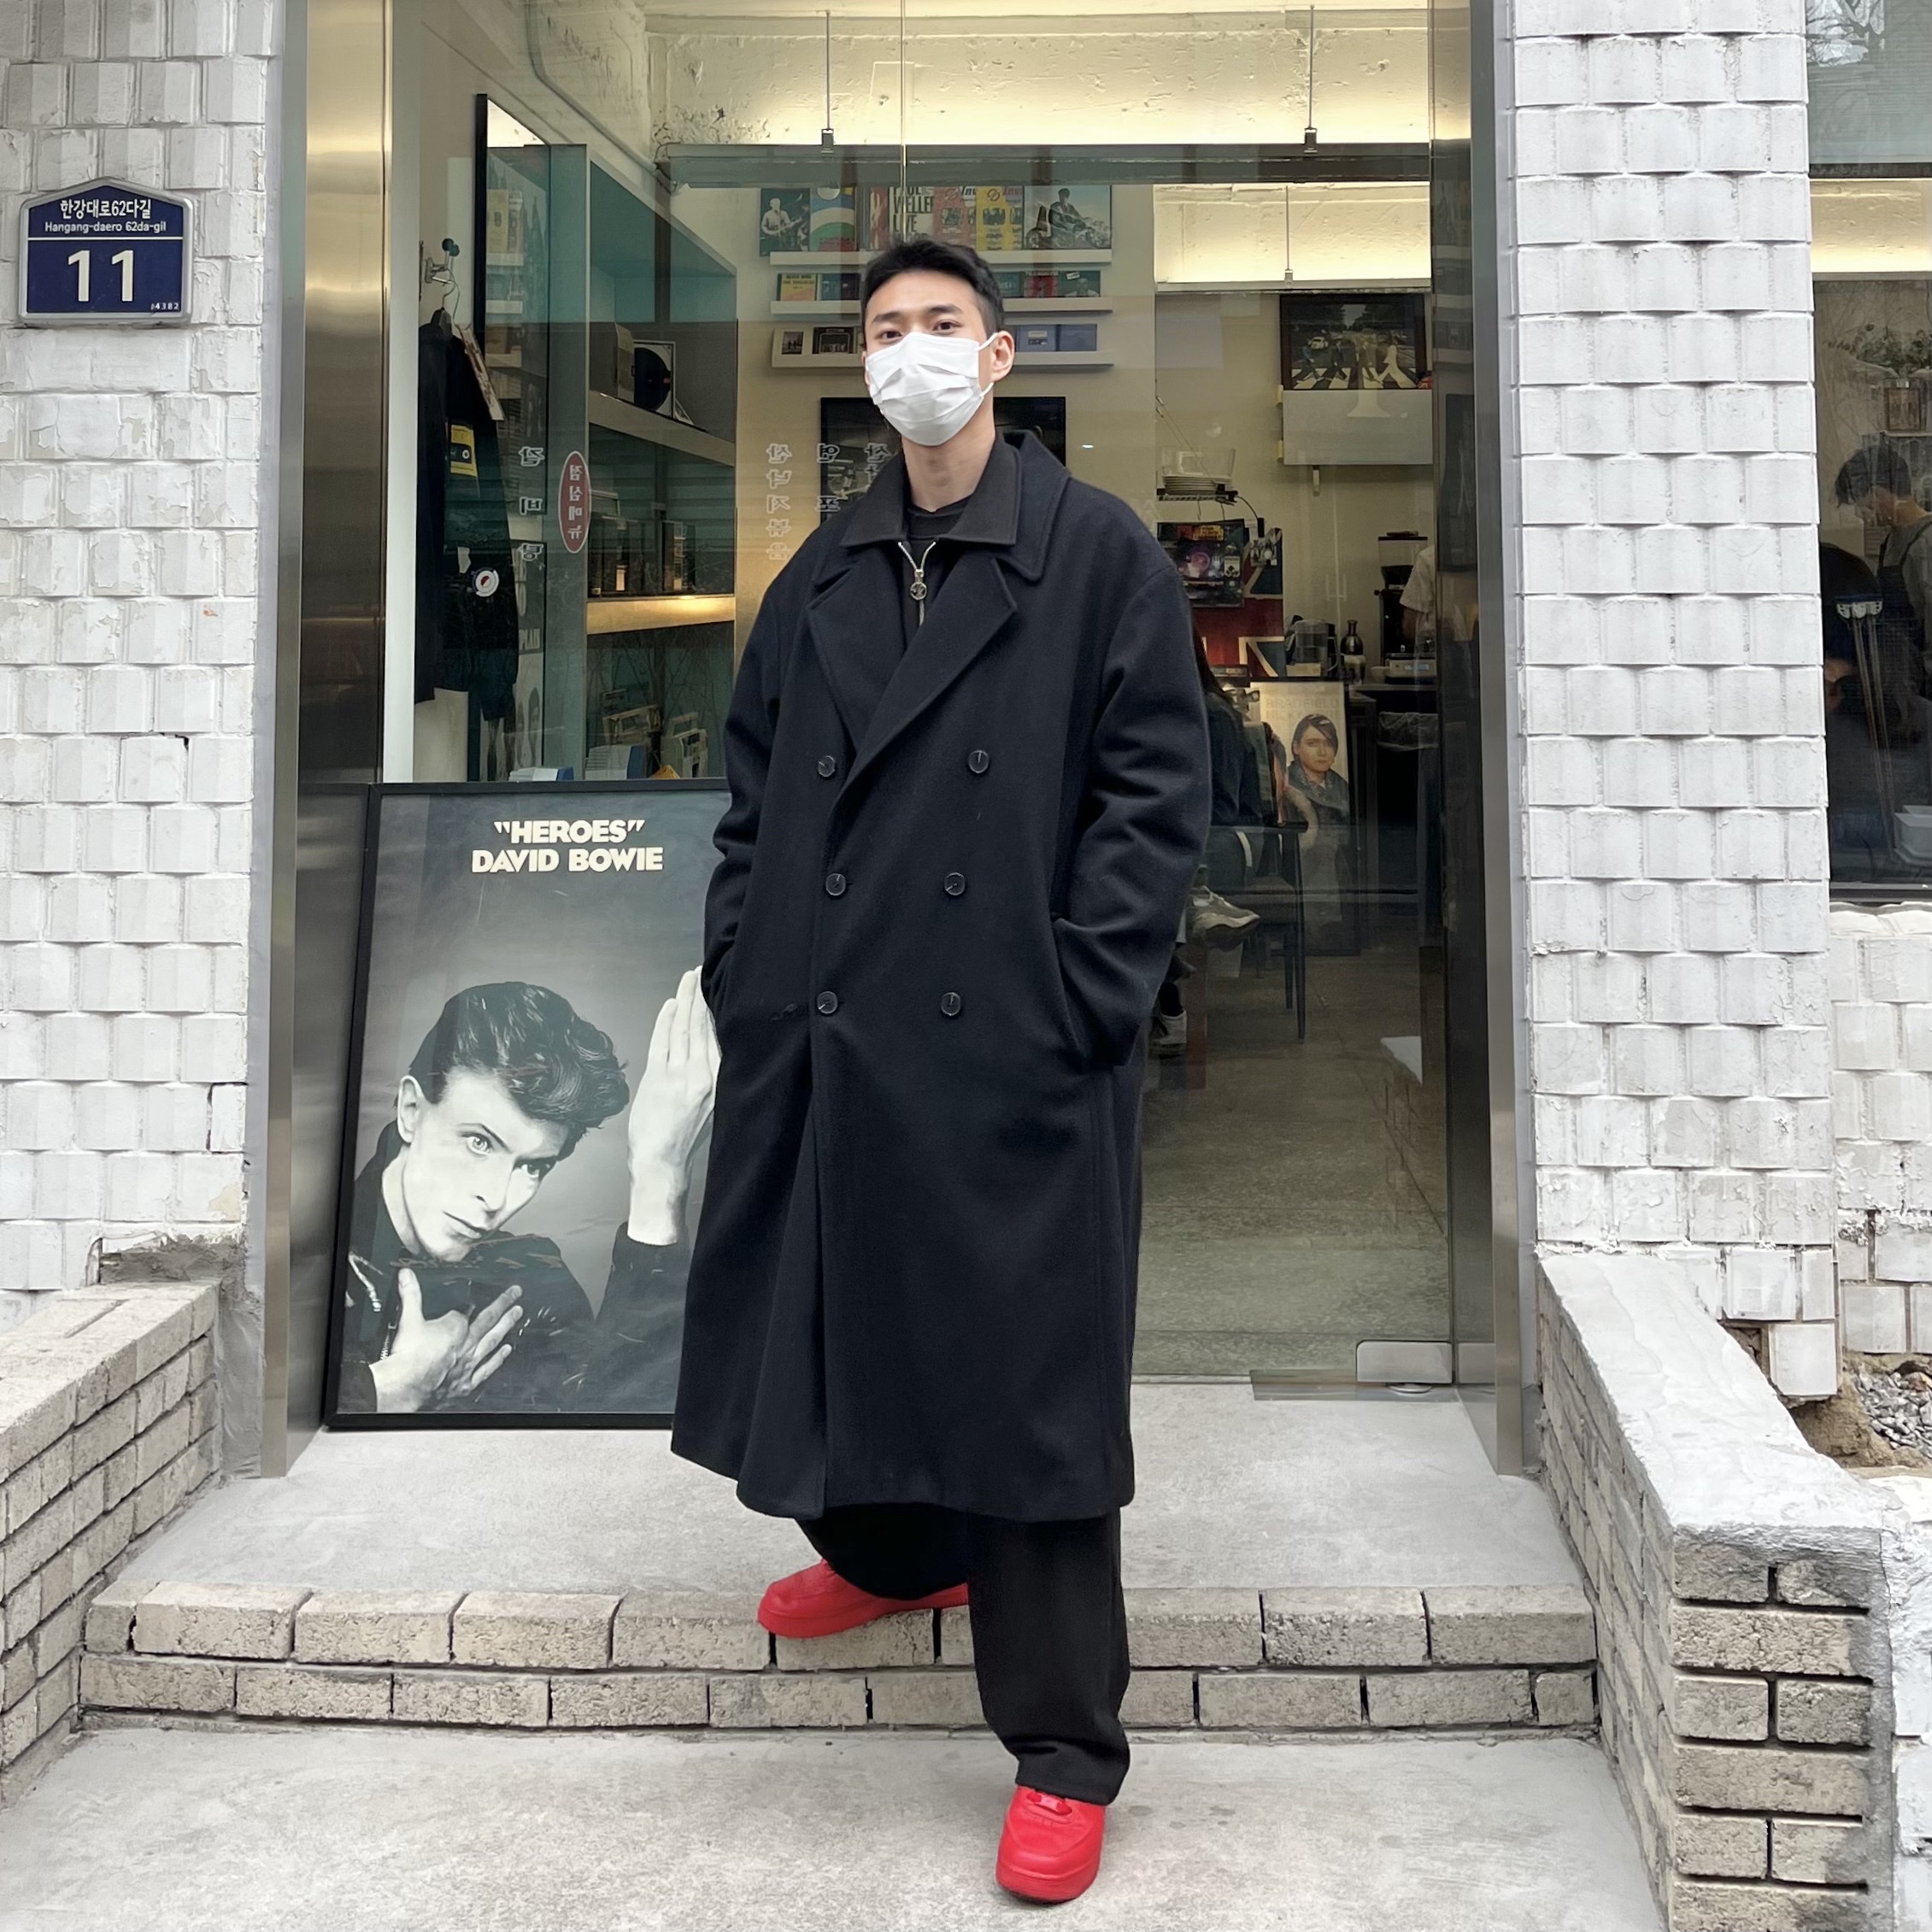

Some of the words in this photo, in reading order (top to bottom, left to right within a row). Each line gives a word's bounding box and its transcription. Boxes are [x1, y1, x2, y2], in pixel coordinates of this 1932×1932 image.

[60, 199, 152, 220] 한강대로62다길
[44, 221, 122, 234] Hangang-daero
[126, 221, 167, 234] 62da-gil
[68, 250, 134, 302] 11
[494, 819, 645, 844] "HEROES"
[472, 849, 560, 873] DAVID
[568, 847, 663, 872] BOWIE
